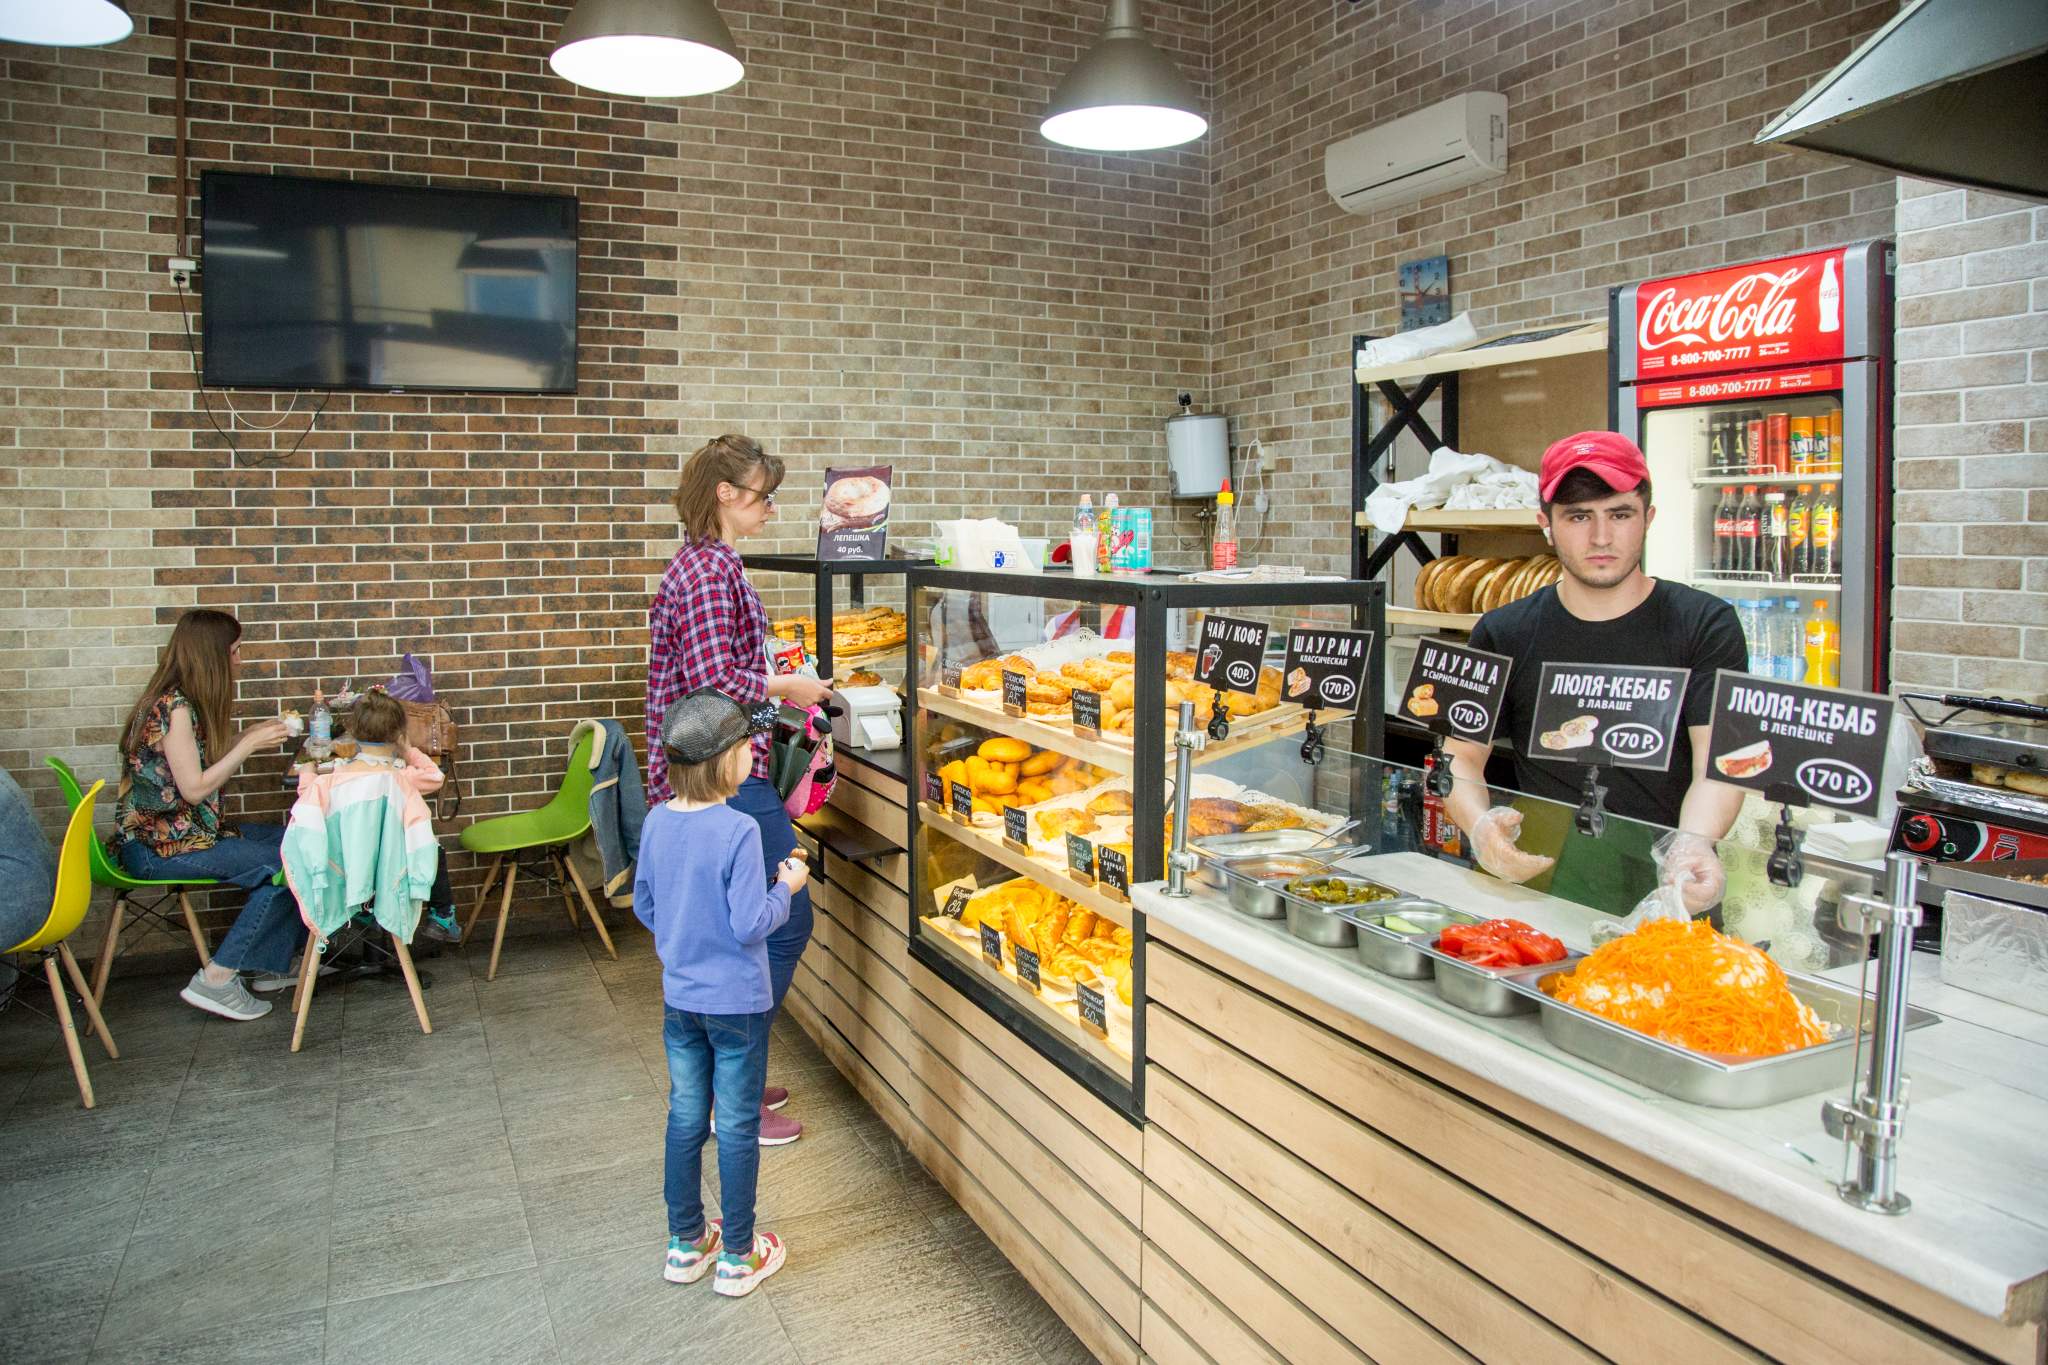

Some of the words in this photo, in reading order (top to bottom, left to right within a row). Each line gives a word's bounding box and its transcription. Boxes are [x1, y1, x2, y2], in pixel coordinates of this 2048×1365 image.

[1640, 265, 1810, 350] Coca-Cola
[1671, 346, 1751, 366] 8-800-700-7777
[1690, 378, 1772, 398] 8-800-700-7777
[833, 534, 870, 542] ЛЕПЕШКА
[848, 546, 864, 555] руб.
[1208, 620, 1226, 639] ЧАЙ
[1233, 626, 1263, 646] КОФЕ
[1293, 635, 1362, 658] ШАУРМА
[1300, 654, 1348, 666] КЛАССИЧЕСКАЯ
[1422, 647, 1499, 686] ШАУРМА
[1325, 682, 1341, 694] 170
[1423, 669, 1428, 678] В
[1428, 671, 1459, 686] СЫРНОМ
[1458, 680, 1490, 695] ЛАВАШЕ
[1550, 674, 1672, 701] ЛЮЛЯ-КЕБАБ
[1455, 706, 1473, 723] 170
[1577, 698, 1585, 708] В
[1586, 699, 1633, 711] ЛАВАШЕ
[1727, 686, 1878, 736] ЛЮЛЯ-КЕБАБ
[1610, 732, 1639, 749] 170
[1760, 719, 1768, 732] В
[1771, 723, 1834, 744] ЛЕПЁШКЕ
[1807, 767, 1840, 791] 170
